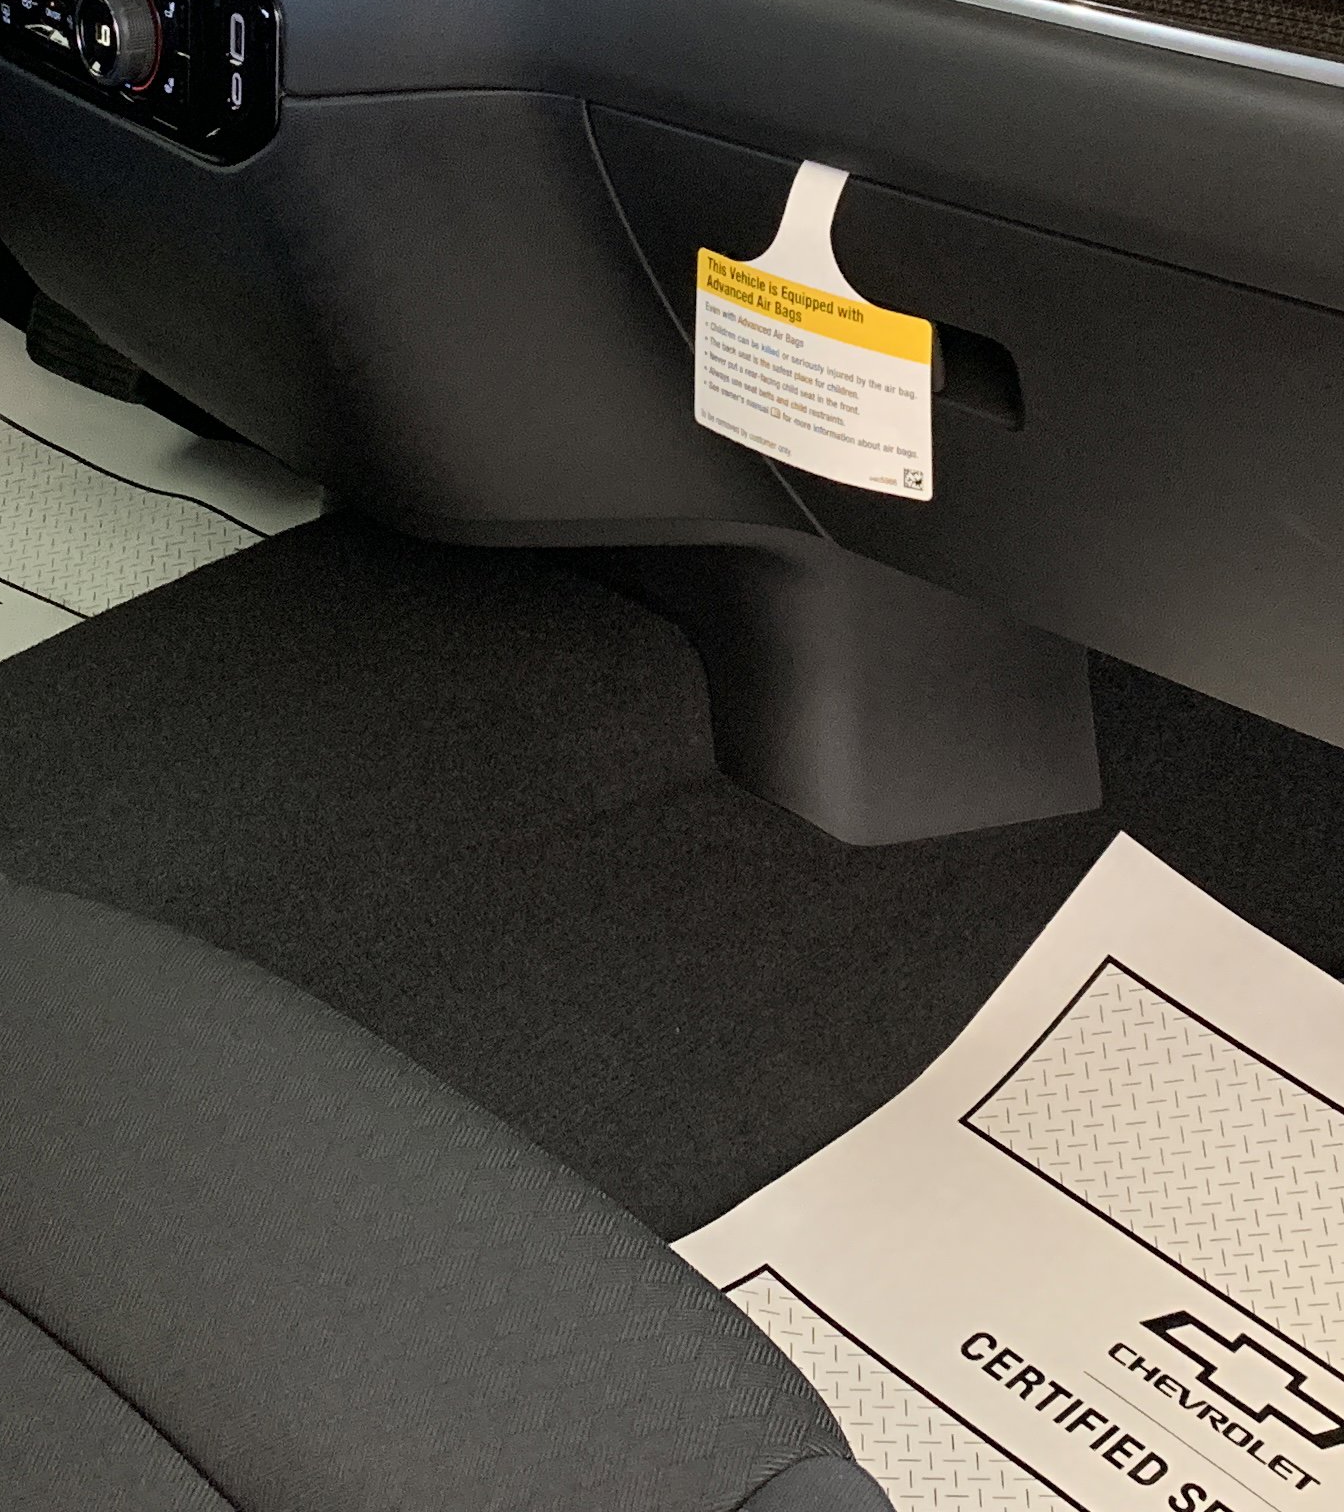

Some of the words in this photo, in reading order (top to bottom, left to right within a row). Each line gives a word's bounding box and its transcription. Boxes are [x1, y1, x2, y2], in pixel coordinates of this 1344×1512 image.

[707, 275, 754, 305] Advanced
[757, 295, 771, 311] Air
[775, 302, 802, 323] Bags
[708, 256, 727, 277] This
[730, 267, 765, 291] Vehicle
[769, 281, 778, 296] is
[781, 286, 833, 314] Equipped
[838, 305, 864, 324] with
[738, 316, 771, 336] Advanced
[773, 329, 783, 340] Air
[785, 333, 804, 349] Bags
[738, 336, 749, 345] can
[761, 344, 780, 358] killed
[782, 353, 789, 361] or
[791, 356, 824, 375] seriously
[827, 366, 854, 383] injured
[856, 375, 866, 387] by
[869, 379, 882, 390] the
[884, 384, 896, 393] air
[899, 387, 917, 400] bag.
[760, 358, 770, 369] the
[772, 364, 793, 377] safest
[794, 372, 813, 385] place
[815, 378, 825, 388] for
[800, 389, 815, 400] seat
[818, 394, 824, 403] in
[826, 397, 838, 408] the
[813, 424, 855, 444] information
[858, 438, 880, 451] about
[883, 444, 894, 453] air
[960, 1332, 1169, 1486] CERTIFIED
[1108, 1342, 1321, 1490] CHEVROLET
